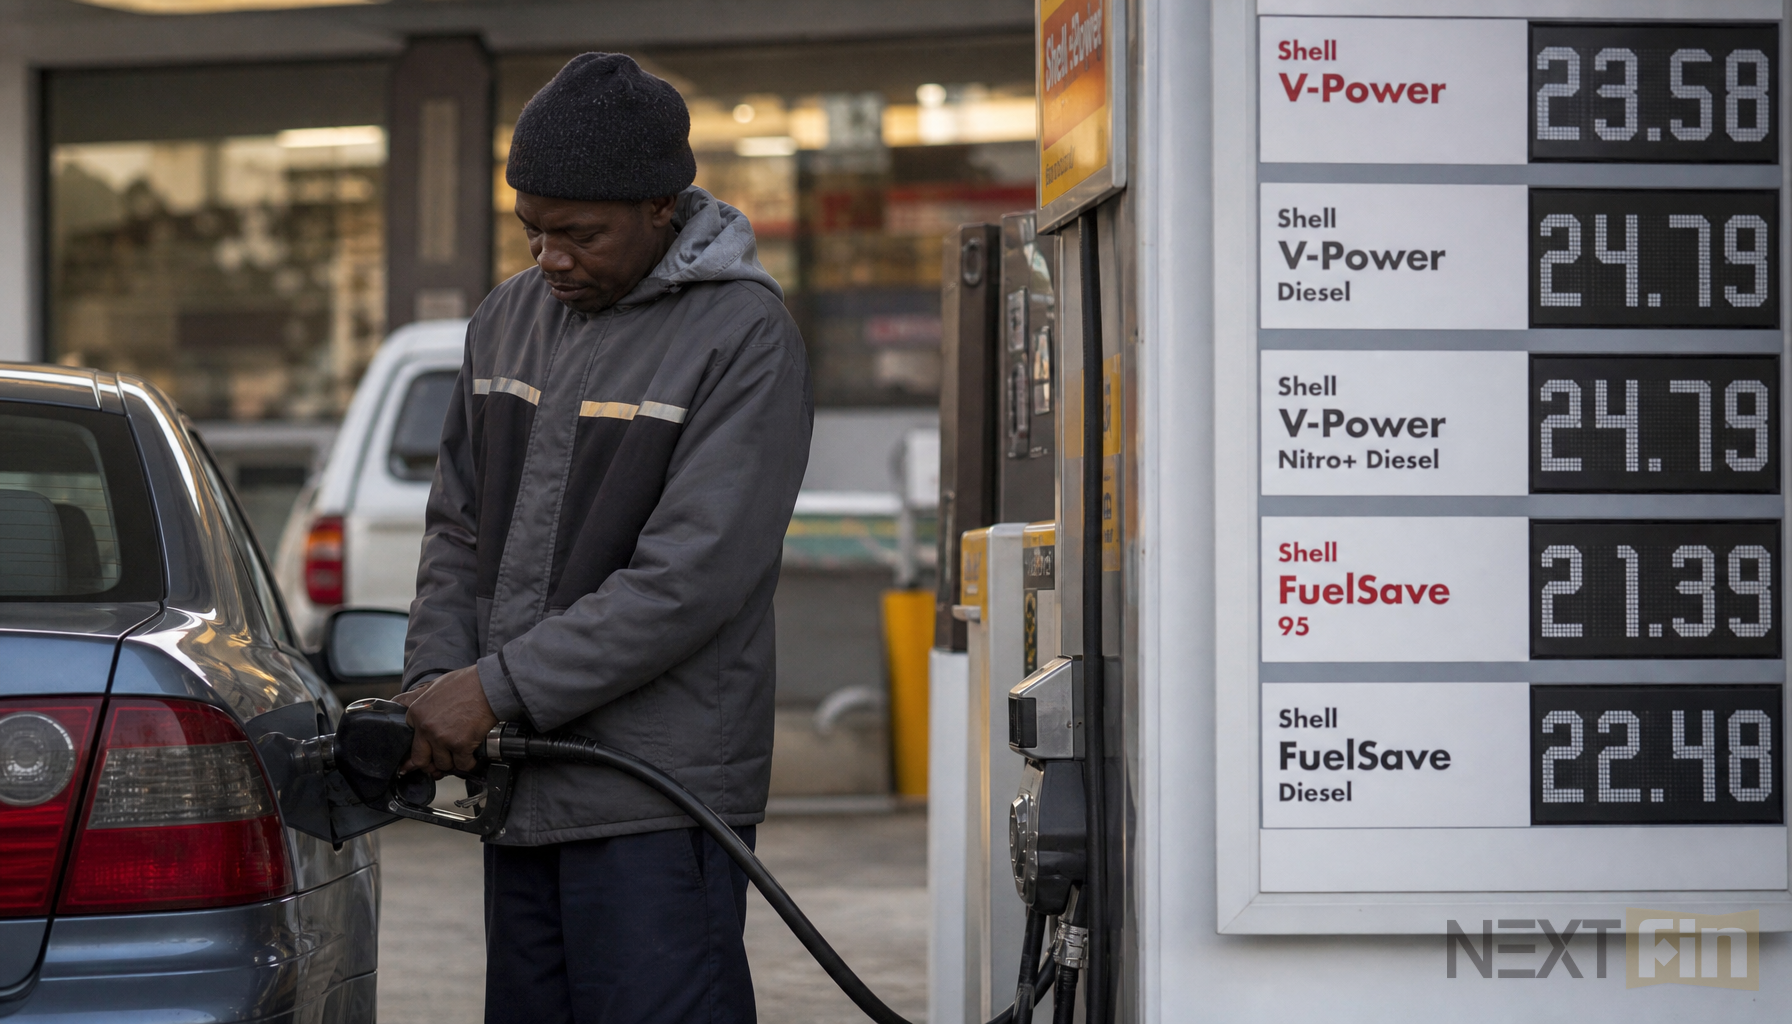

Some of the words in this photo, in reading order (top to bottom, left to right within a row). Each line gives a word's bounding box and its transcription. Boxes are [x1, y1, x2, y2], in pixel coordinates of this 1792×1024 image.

[1046, 23, 1068, 92] Shell
[1277, 39, 1337, 61] Shell
[1279, 73, 1447, 104] V-Power
[1536, 46, 1769, 142] 23.58
[1278, 207, 1336, 229] Shell
[1279, 241, 1446, 271] V-Power
[1540, 214, 1768, 307] 24.79
[1278, 281, 1351, 302] Diesel
[1278, 375, 1337, 397] Shell
[1279, 408, 1447, 439] V-Power
[1540, 379, 1768, 472] 24.79
[1278, 448, 1357, 469] Nitro+
[1366, 448, 1439, 470] Diesel
[1278, 541, 1337, 563] Shell
[1279, 573, 1450, 605] FuelSave
[1541, 545, 1771, 638] 21.39
[1278, 617, 1310, 637] 95
[1278, 707, 1338, 729] Shell
[1279, 739, 1452, 771] FuelSave
[1542, 710, 1772, 803] 22.48
[1279, 781, 1352, 802] Diesel
